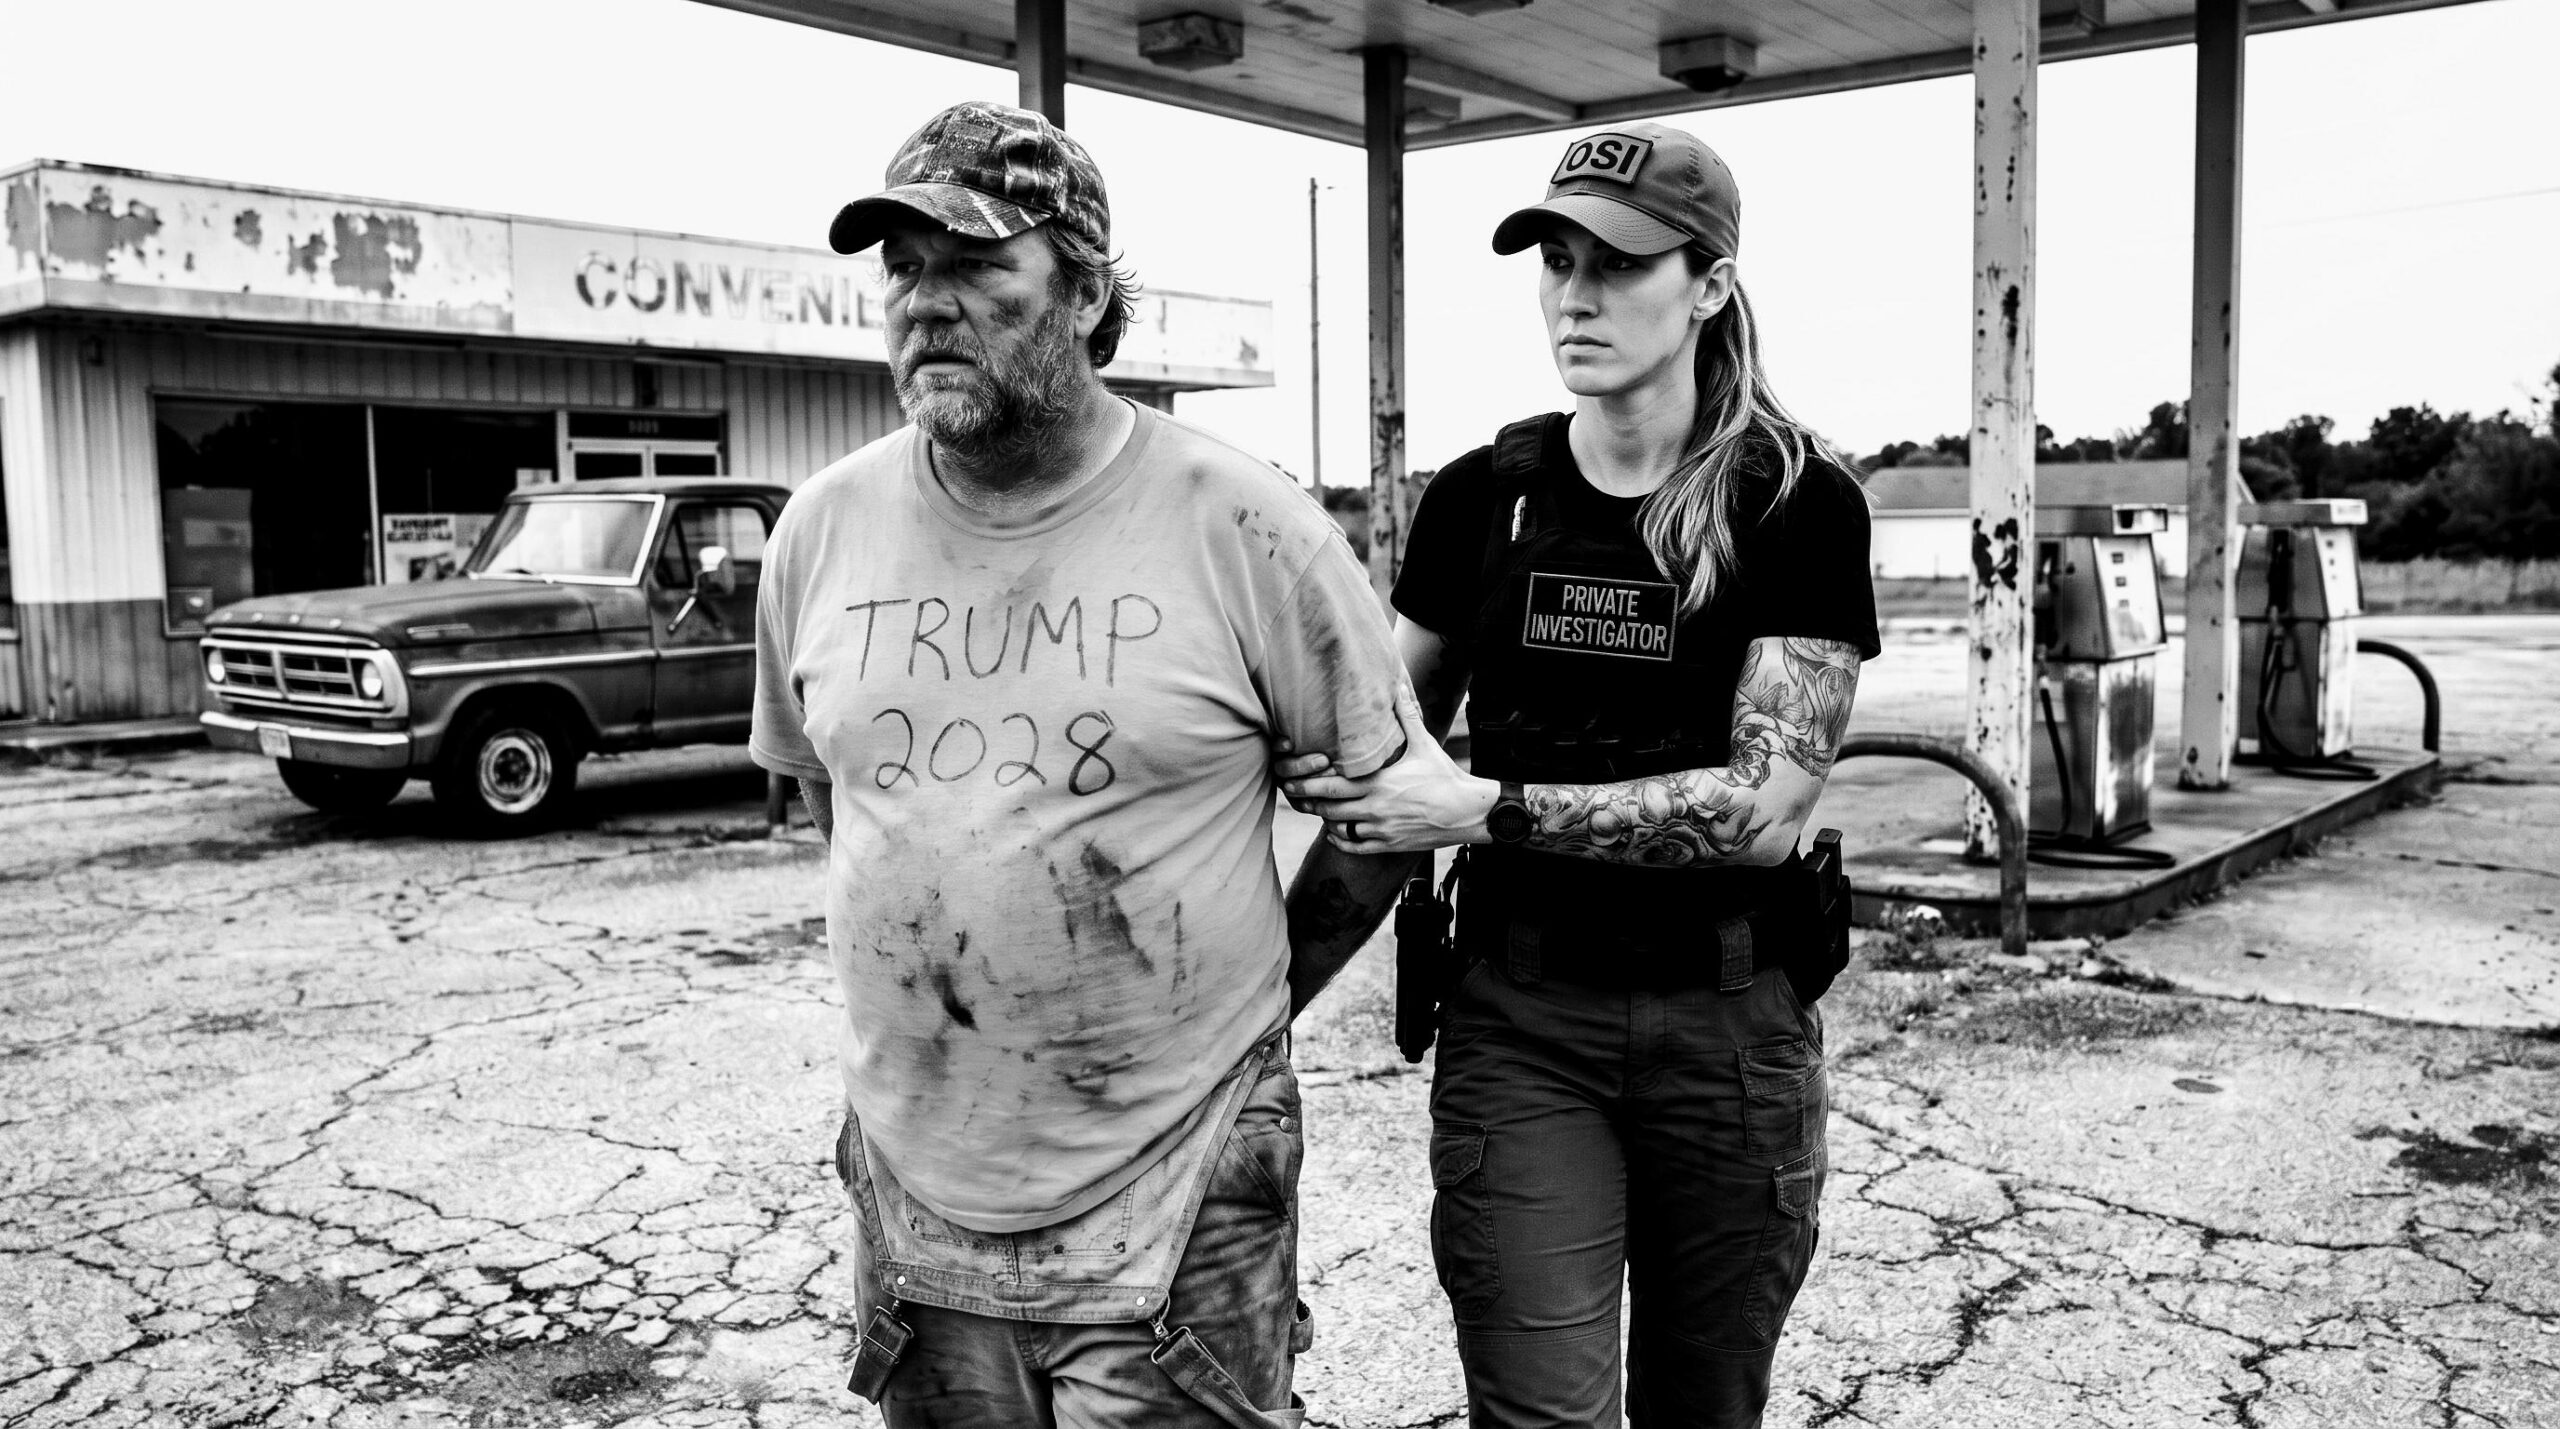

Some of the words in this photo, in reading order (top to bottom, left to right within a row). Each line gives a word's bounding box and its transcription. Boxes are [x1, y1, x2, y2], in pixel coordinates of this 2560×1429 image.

[1566, 140, 1640, 176] OSI
[1562, 584, 1641, 618] PRIVATE
[845, 593, 1163, 688] TRUMP
[1530, 613, 1668, 652] INVESTIGATOR
[871, 708, 1117, 796] 2028
